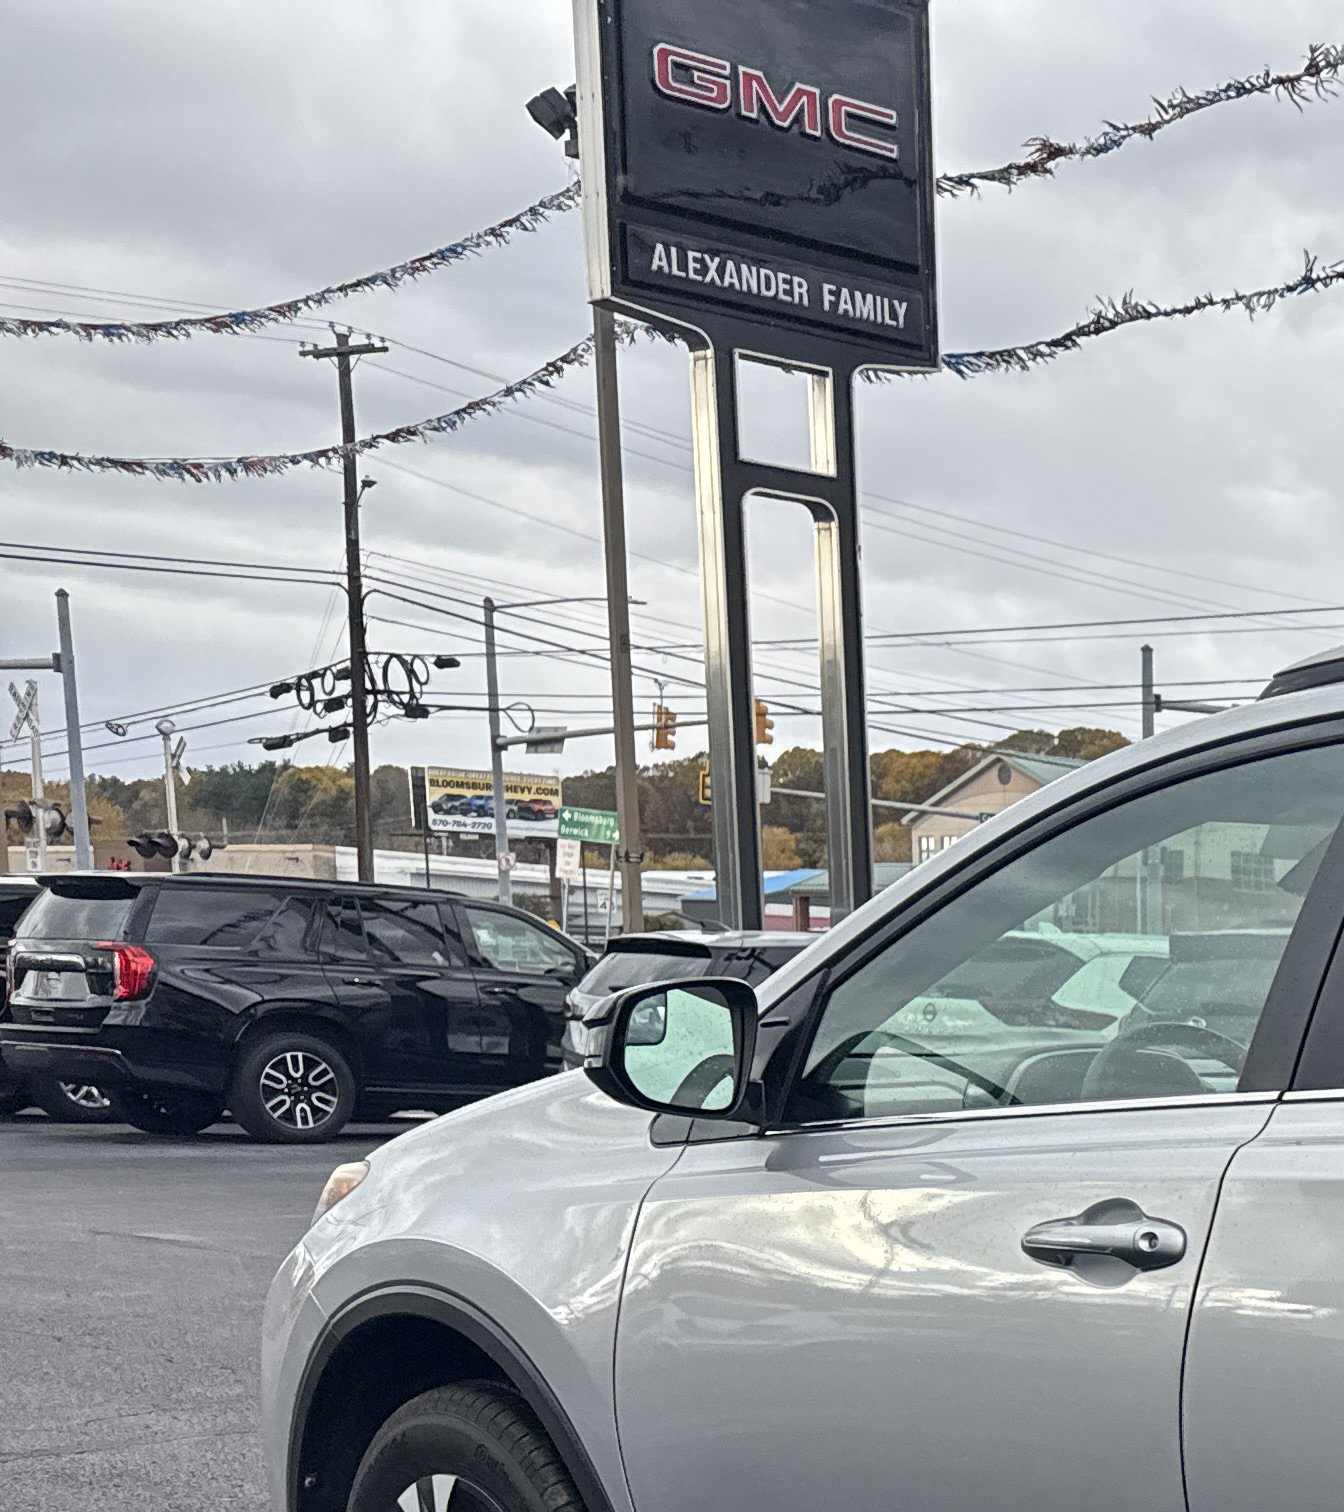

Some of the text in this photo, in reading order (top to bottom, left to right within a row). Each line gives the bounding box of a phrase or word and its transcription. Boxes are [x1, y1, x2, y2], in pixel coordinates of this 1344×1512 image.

[653, 43, 898, 158] GMC
[651, 243, 908, 329] ALEXANDER FAMILY
[429, 778, 559, 797] BLOOMSBURHEVY.COM
